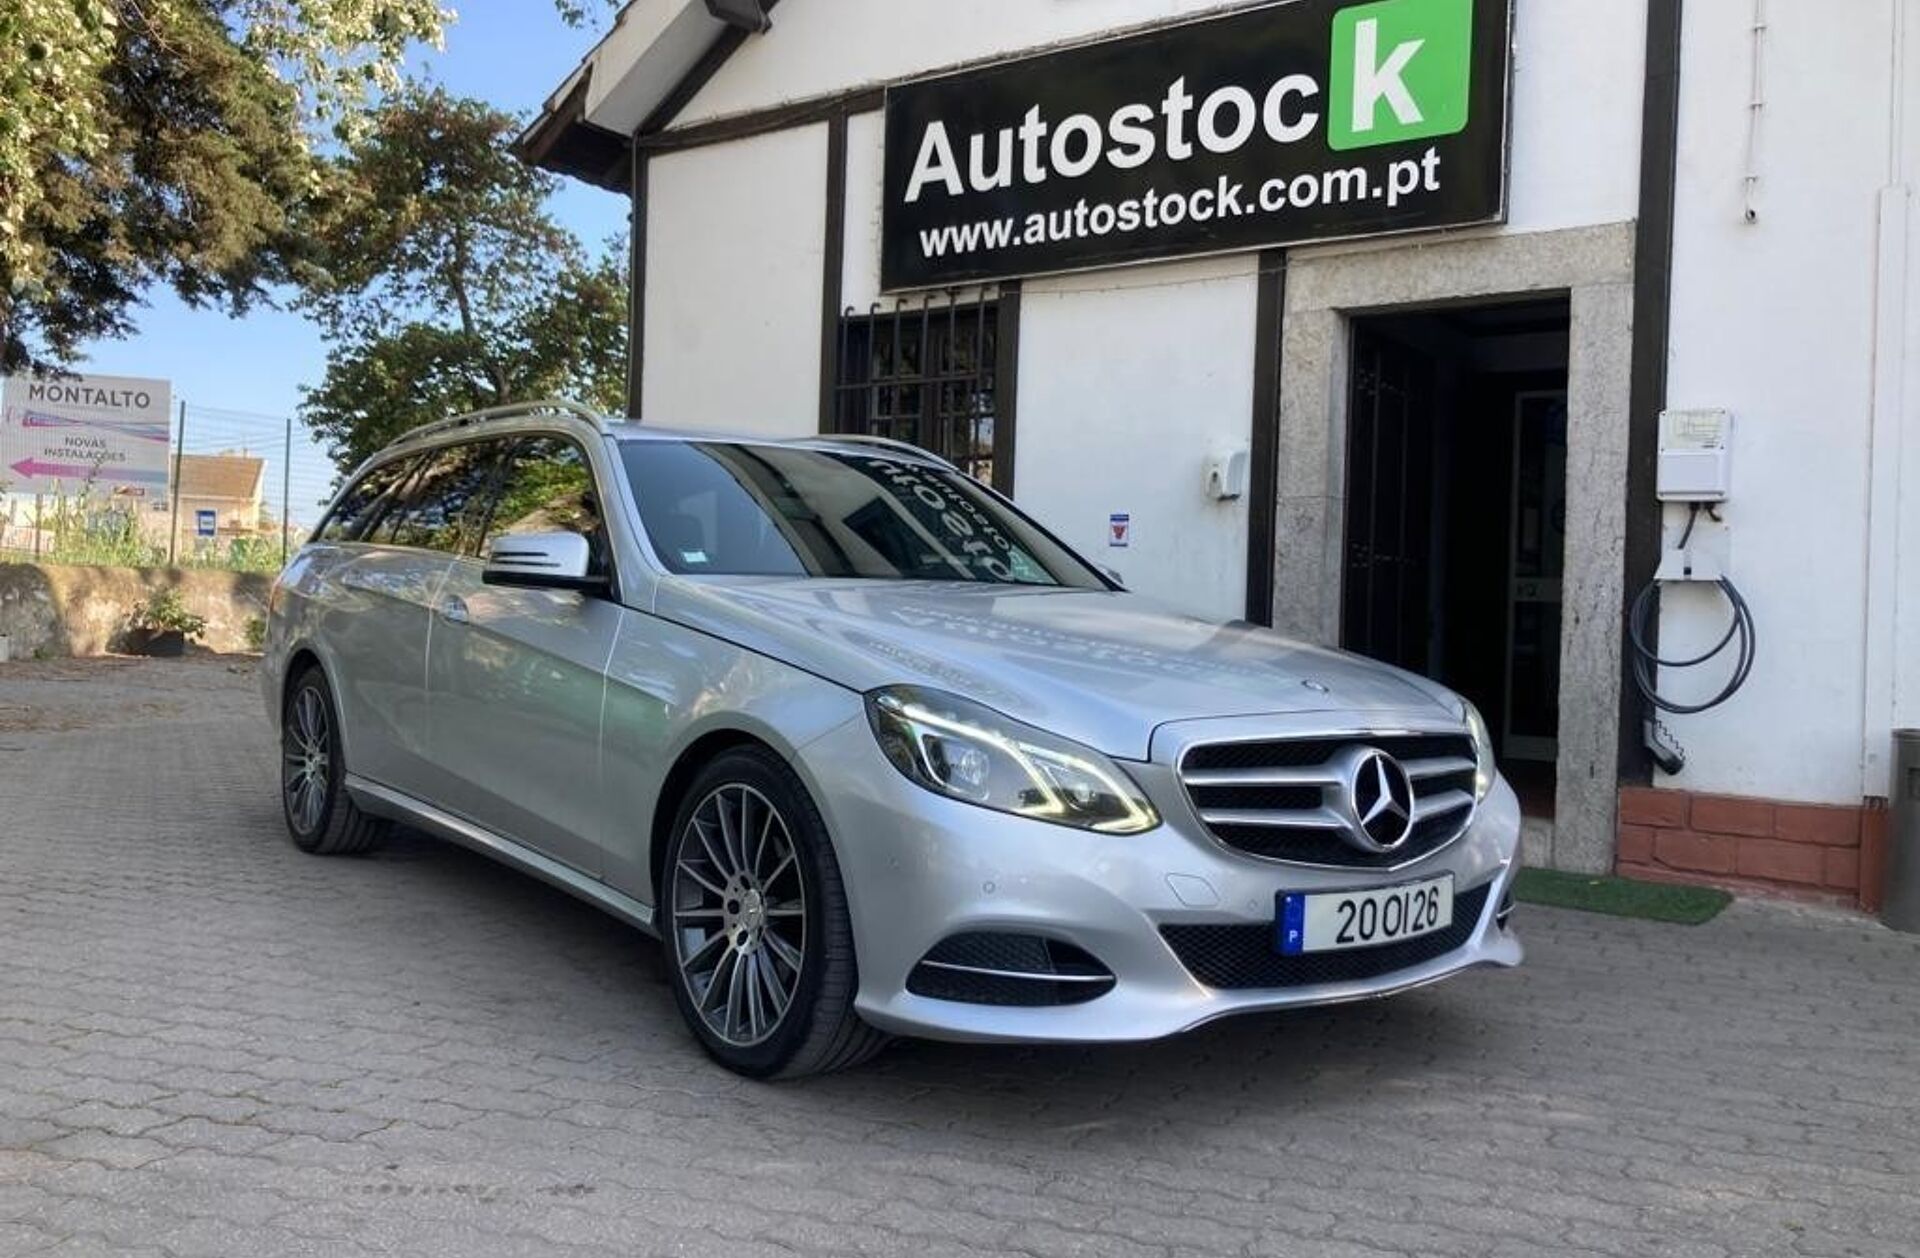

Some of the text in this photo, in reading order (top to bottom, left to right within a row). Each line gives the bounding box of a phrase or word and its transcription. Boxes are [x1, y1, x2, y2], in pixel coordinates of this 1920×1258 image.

[904, 17, 1426, 202] Autostock
[919, 147, 1441, 258] www.autostock.com.pt
[29, 384, 151, 409] MONTALTO
[64, 436, 107, 449] NOVAS
[1289, 930, 1298, 943] P
